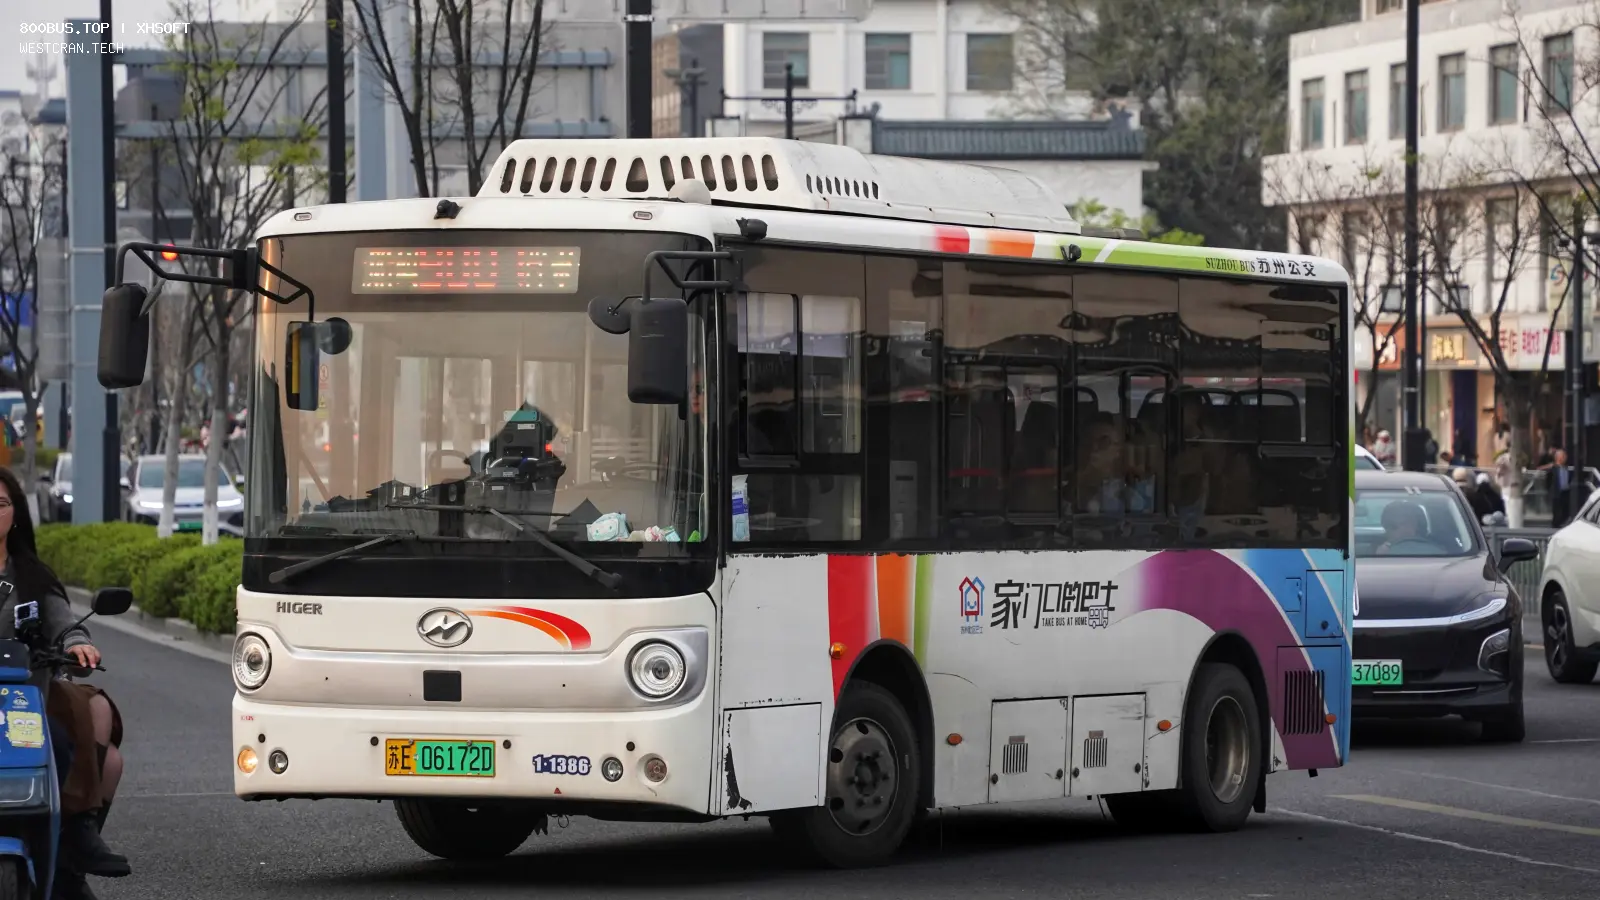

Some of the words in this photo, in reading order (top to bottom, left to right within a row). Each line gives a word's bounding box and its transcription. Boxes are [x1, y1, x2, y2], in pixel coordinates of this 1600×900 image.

[1205, 257, 1238, 272] SUZHOU
[1239, 259, 1256, 273] BUS
[1256, 257, 1316, 277] 苏州公交
[276, 601, 323, 615] HIGER
[990, 579, 1118, 629] 家门口的巴士
[1042, 617, 1054, 627] TAKE
[1055, 617, 1066, 627] BUS
[1067, 617, 1074, 626] AT
[1075, 616, 1088, 626] HOME
